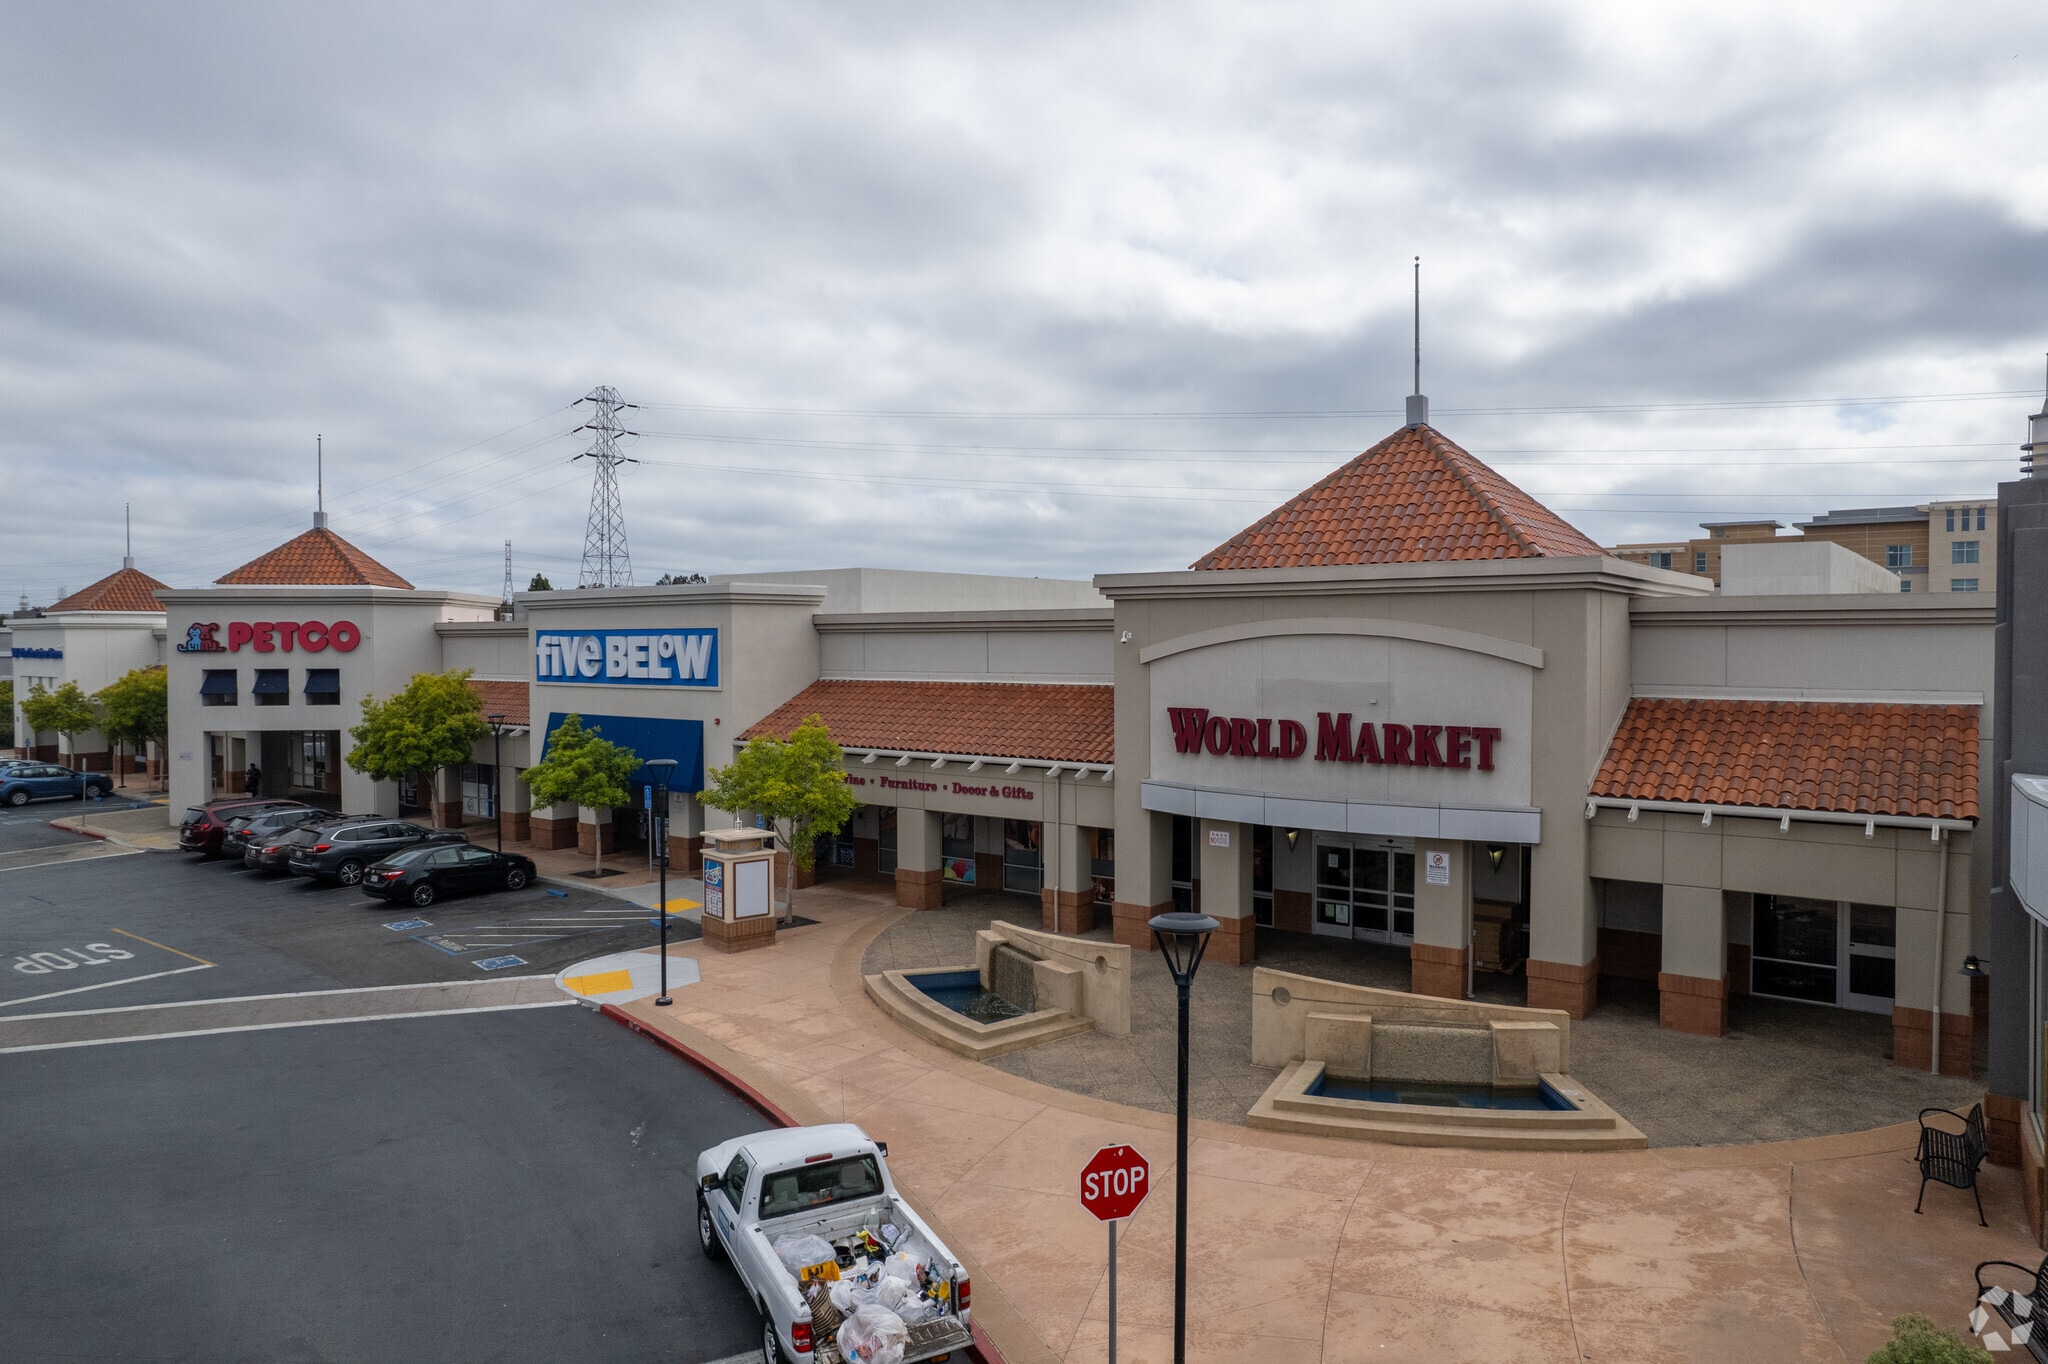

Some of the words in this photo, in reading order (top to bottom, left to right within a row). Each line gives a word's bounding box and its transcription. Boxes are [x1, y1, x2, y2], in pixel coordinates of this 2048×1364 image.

[228, 620, 361, 653] PETCO
[1167, 707, 1308, 758] WORLD
[1314, 712, 1502, 771] MARKET
[880, 776, 938, 792] Furniture
[989, 786, 999, 797] &
[1002, 786, 1035, 800] Gifts
[14, 943, 135, 974] STOP
[1084, 1166, 1145, 1200] STOP
